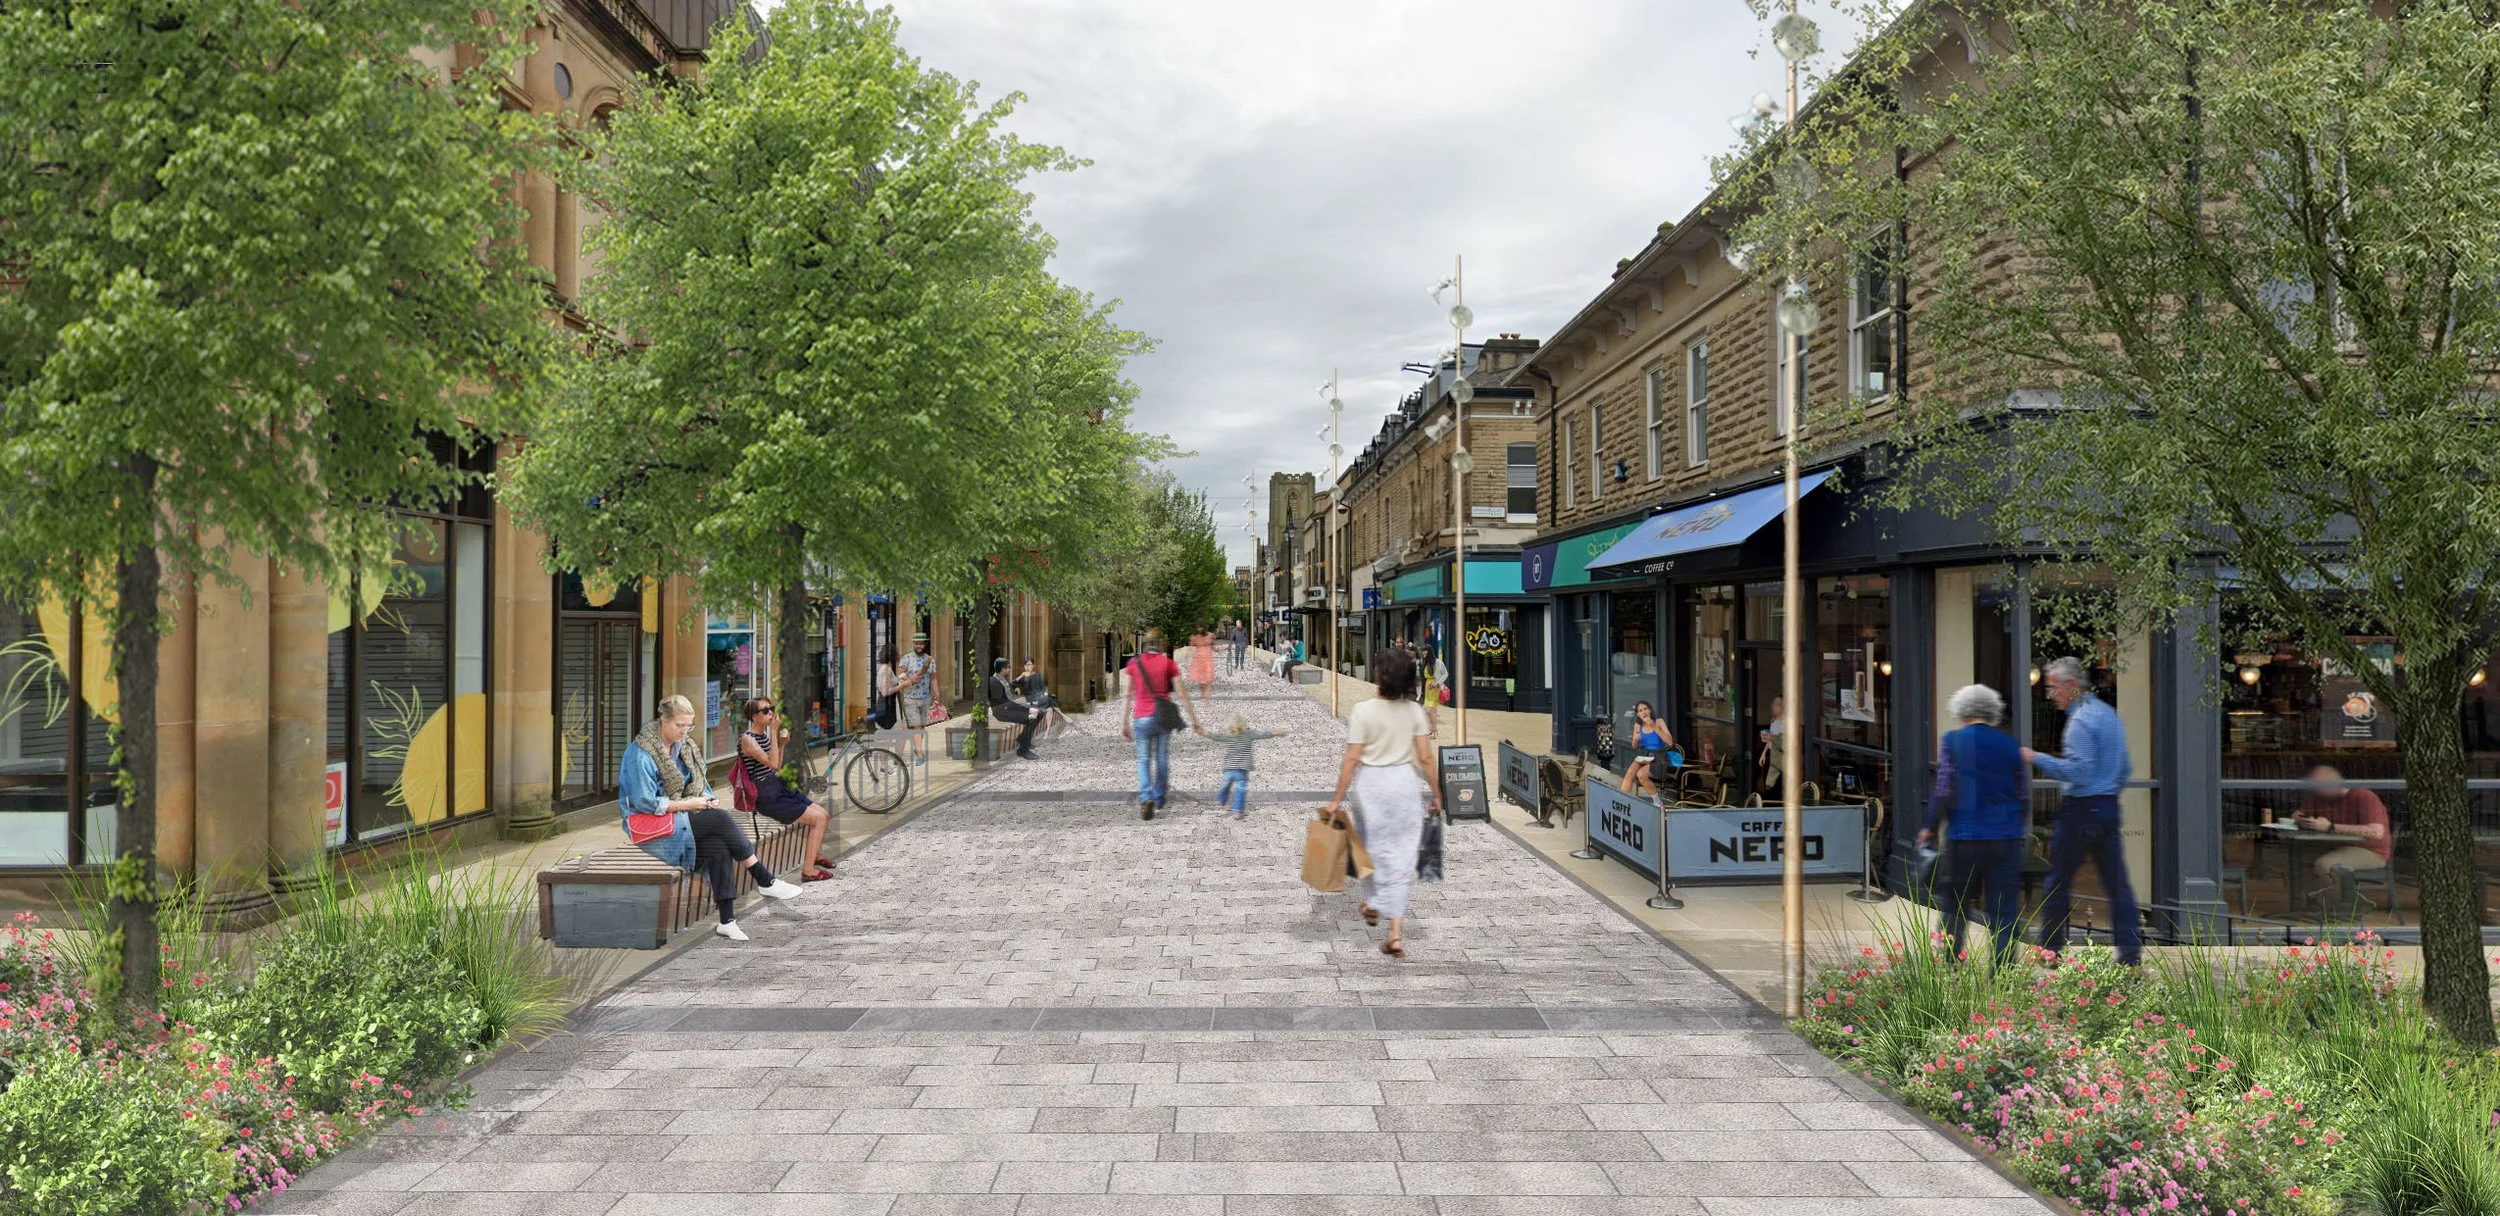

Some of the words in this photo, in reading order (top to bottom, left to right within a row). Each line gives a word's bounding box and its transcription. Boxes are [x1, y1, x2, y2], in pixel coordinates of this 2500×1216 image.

[1644, 562, 1665, 573] COFFEE
[1601, 808, 1643, 852] NERO
[1741, 821, 1784, 832] CAFF
